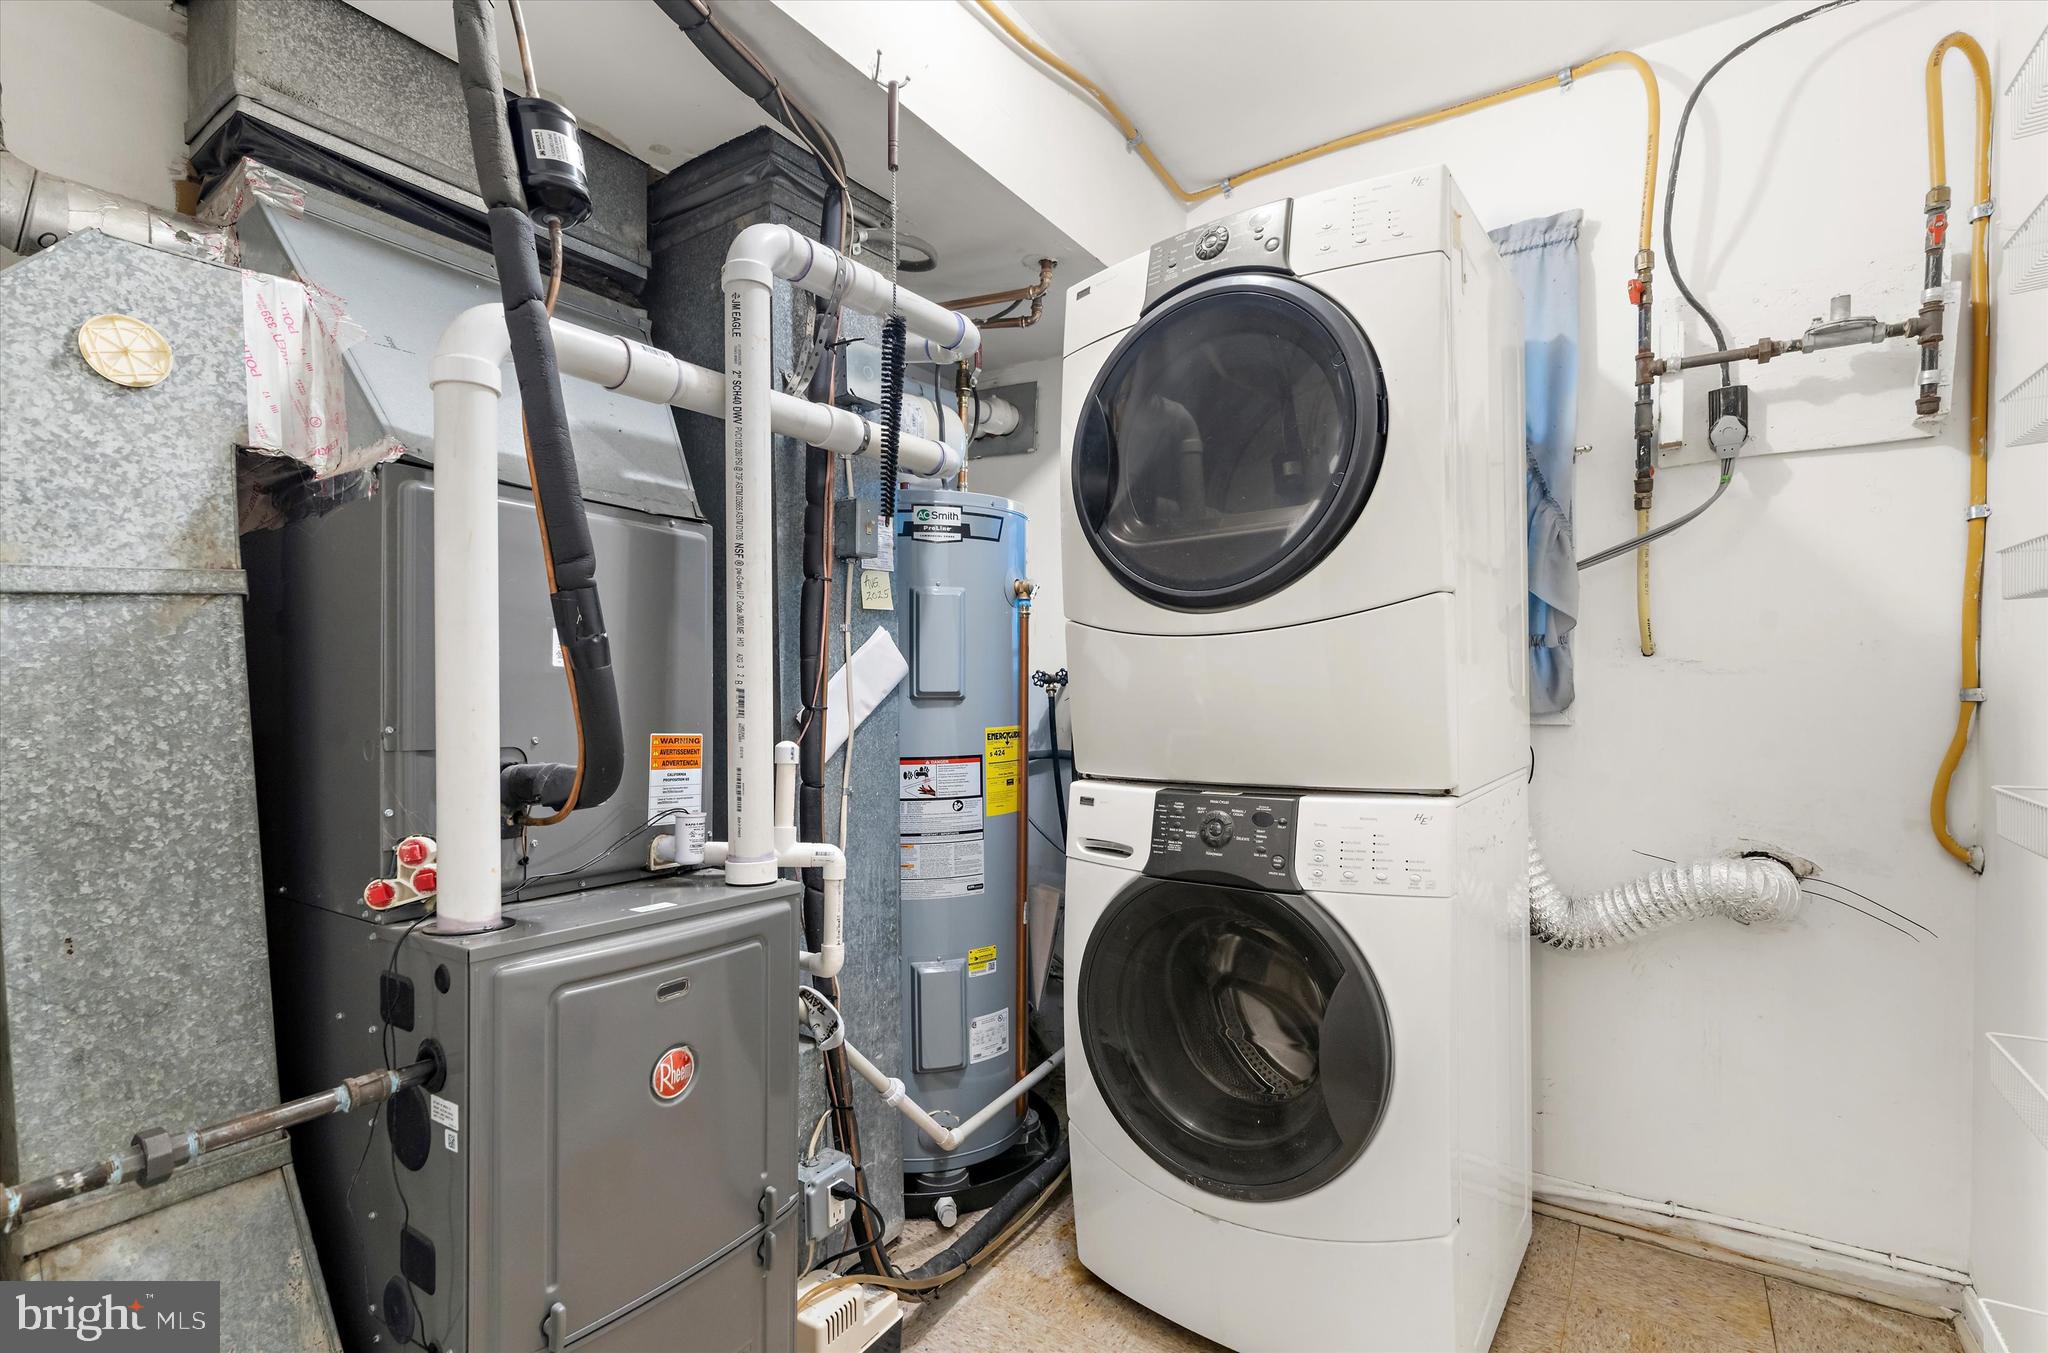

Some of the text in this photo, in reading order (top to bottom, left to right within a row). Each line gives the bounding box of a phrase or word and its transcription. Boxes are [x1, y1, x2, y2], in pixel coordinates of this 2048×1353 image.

[732, 299, 741, 310] JM
[732, 311, 742, 338] EAGLE
[732, 370, 742, 379] 2"
[732, 380, 742, 405] SCH40
[732, 406, 743, 425] DWV
[735, 481, 744, 496] ASTM
[735, 511, 744, 525] ASTM
[931, 511, 959, 521] Smith
[734, 542, 744, 558] NSF
[866, 588, 890, 601] 2025
[660, 748, 700, 756] AVERTISSEMENT
[993, 749, 1006, 757] 424
[659, 1054, 692, 1093] Rheem
